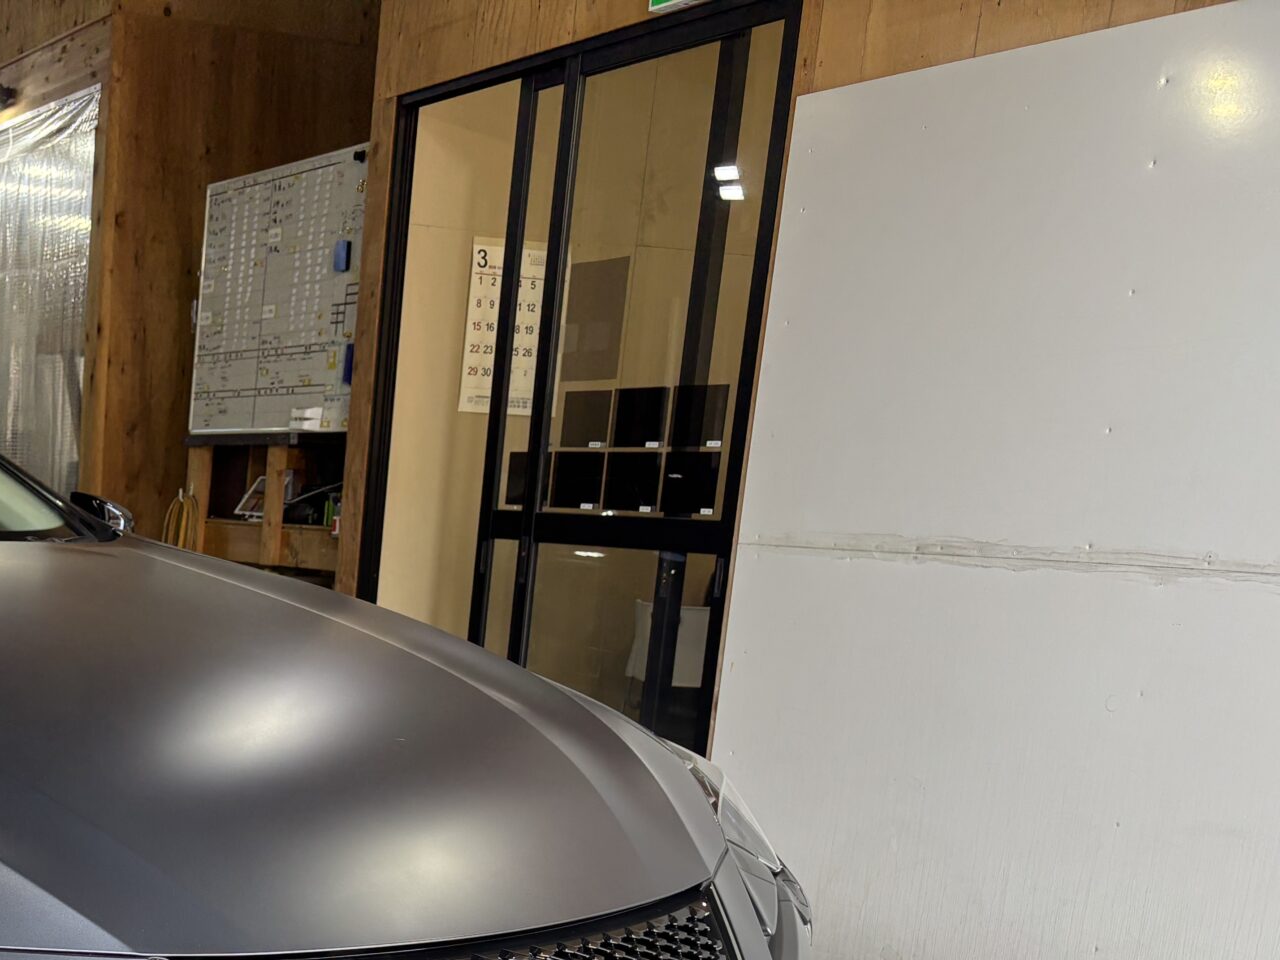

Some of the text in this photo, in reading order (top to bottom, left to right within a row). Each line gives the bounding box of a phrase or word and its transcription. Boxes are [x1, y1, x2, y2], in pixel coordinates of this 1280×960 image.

[477, 249, 488, 268] 3
[479, 276, 483, 286] 1
[491, 277, 497, 287] 2
[530, 280, 536, 290] 5
[476, 298, 482, 308] 8
[489, 299, 495, 309] 9
[527, 303, 536, 313] 12
[472, 321, 481, 331] 15
[485, 322, 495, 332] 16
[524, 325, 534, 335] 19
[469, 343, 480, 354] 22
[483, 345, 493, 355] 23
[522, 348, 532, 358] 26
[467, 366, 491, 377] 29 30
